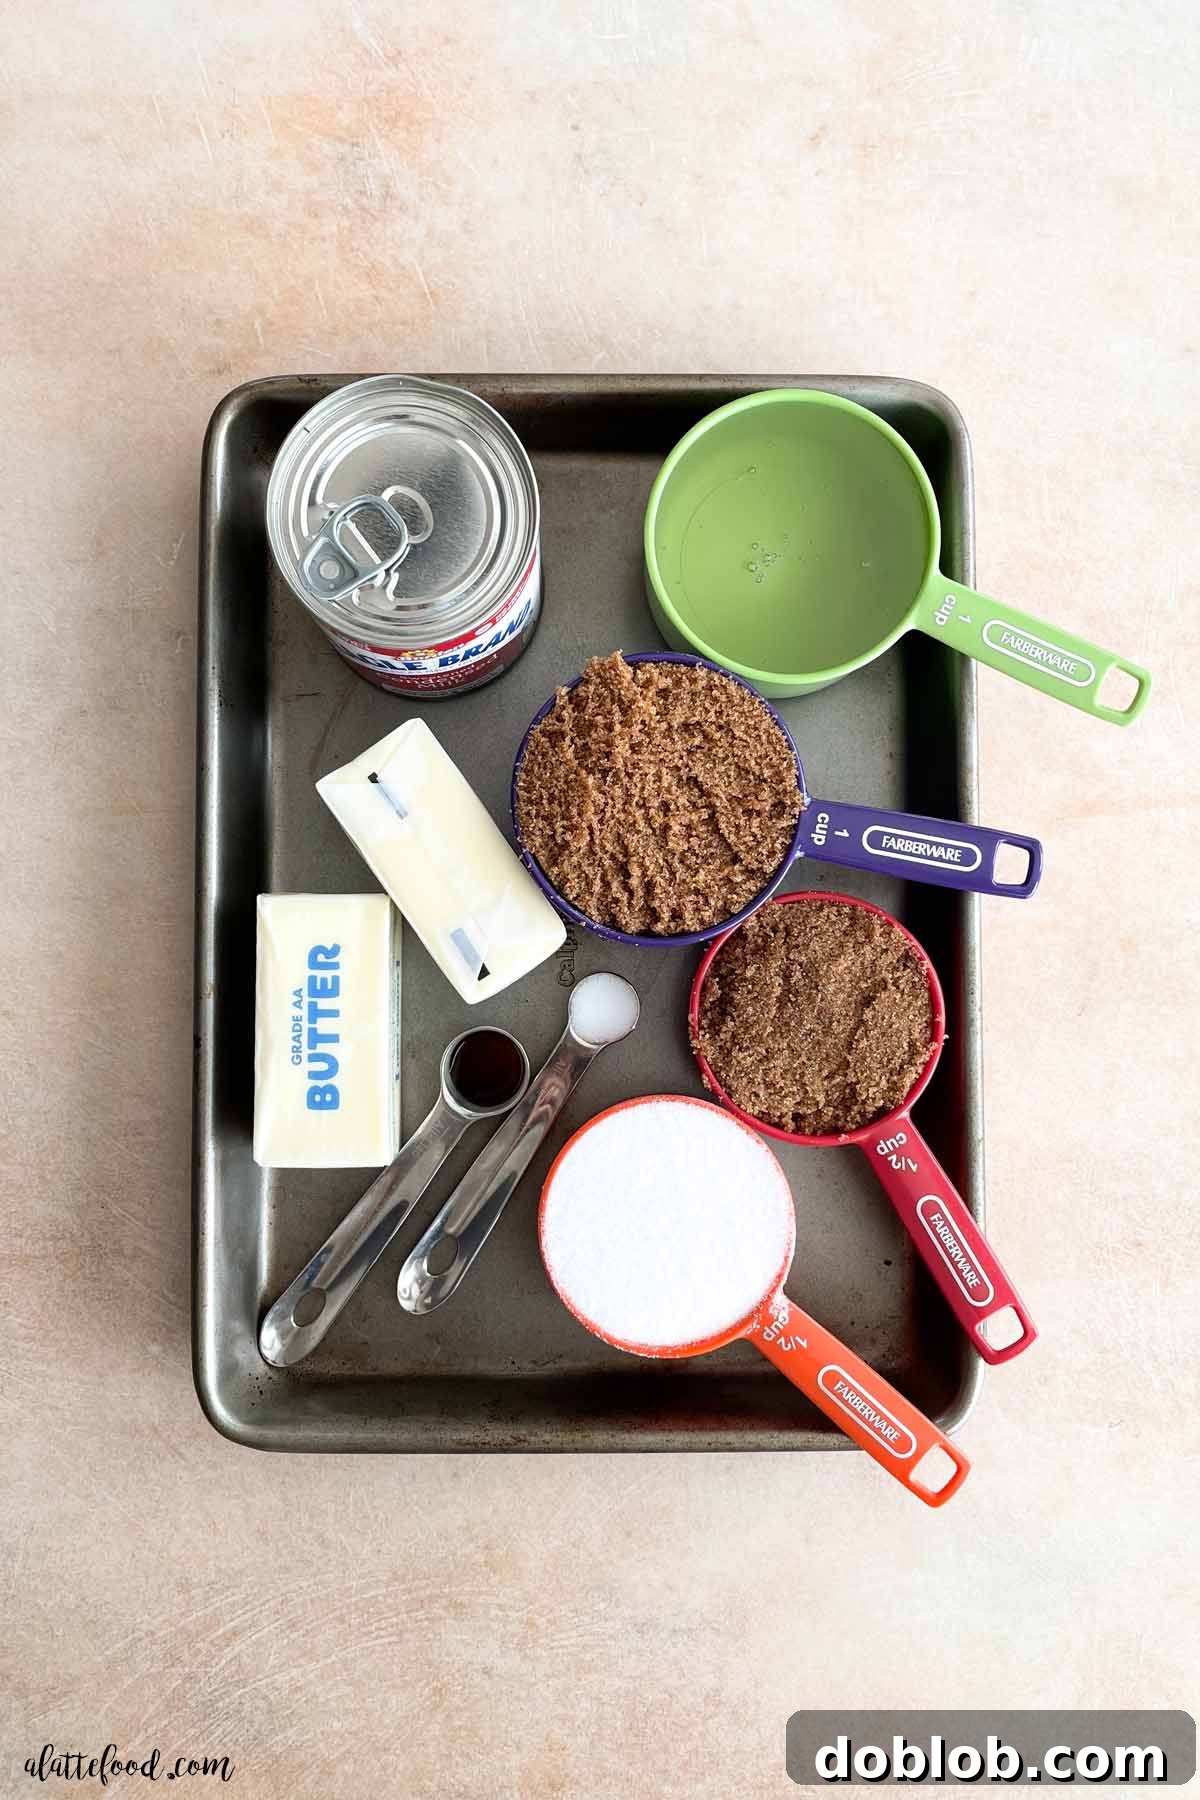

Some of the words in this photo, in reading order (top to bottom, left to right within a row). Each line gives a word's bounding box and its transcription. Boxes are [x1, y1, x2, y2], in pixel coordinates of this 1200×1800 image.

[933, 594, 957, 626] cup
[957, 614, 972, 624] 1
[1001, 631, 1079, 676] FARBERWARE
[811, 812, 829, 846] cup
[834, 829, 850, 838] 1
[881, 835, 963, 863] FARBERWARE
[292, 987, 304, 1010] AA
[291, 1015, 303, 1066] GRADE
[306, 943, 342, 1111] BUTTER
[876, 1131, 907, 1155] cup
[887, 1153, 919, 1173] 1/2
[929, 1212, 981, 1290] FARBERWARE
[762, 1310, 790, 1342] cup
[776, 1335, 809, 1352] 1/2
[833, 1380, 902, 1443] FARBERWARE
